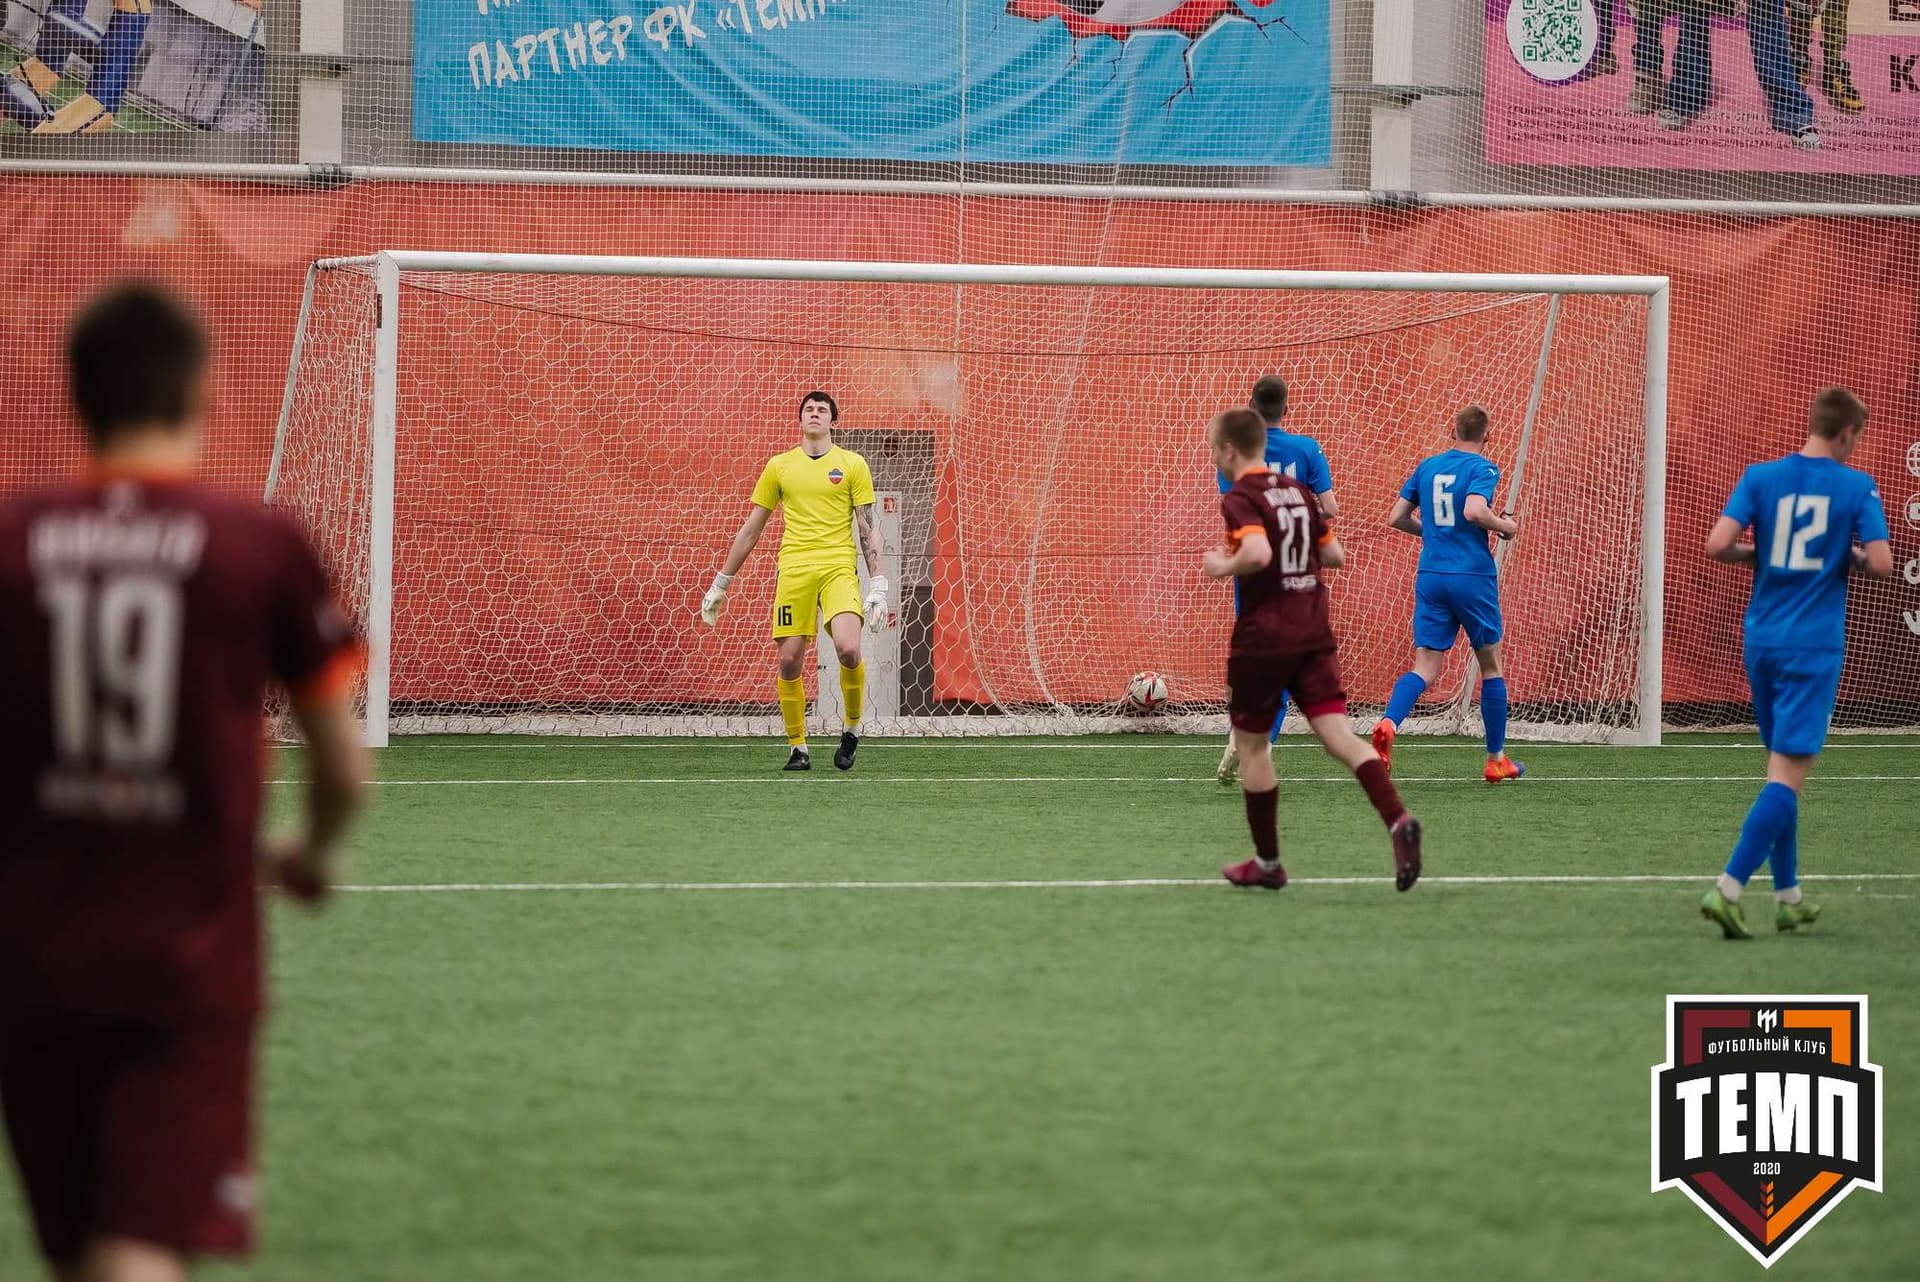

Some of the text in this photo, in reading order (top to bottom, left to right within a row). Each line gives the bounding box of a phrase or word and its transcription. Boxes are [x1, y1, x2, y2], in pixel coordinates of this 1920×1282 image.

[468, 15, 633, 91] ПАРТНЕР
[644, 0, 706, 51] ФК
[1432, 474, 1457, 527] 6
[1769, 492, 1831, 571] 12
[1276, 505, 1311, 574] 27
[777, 604, 793, 627] 16
[42, 574, 184, 765] 19
